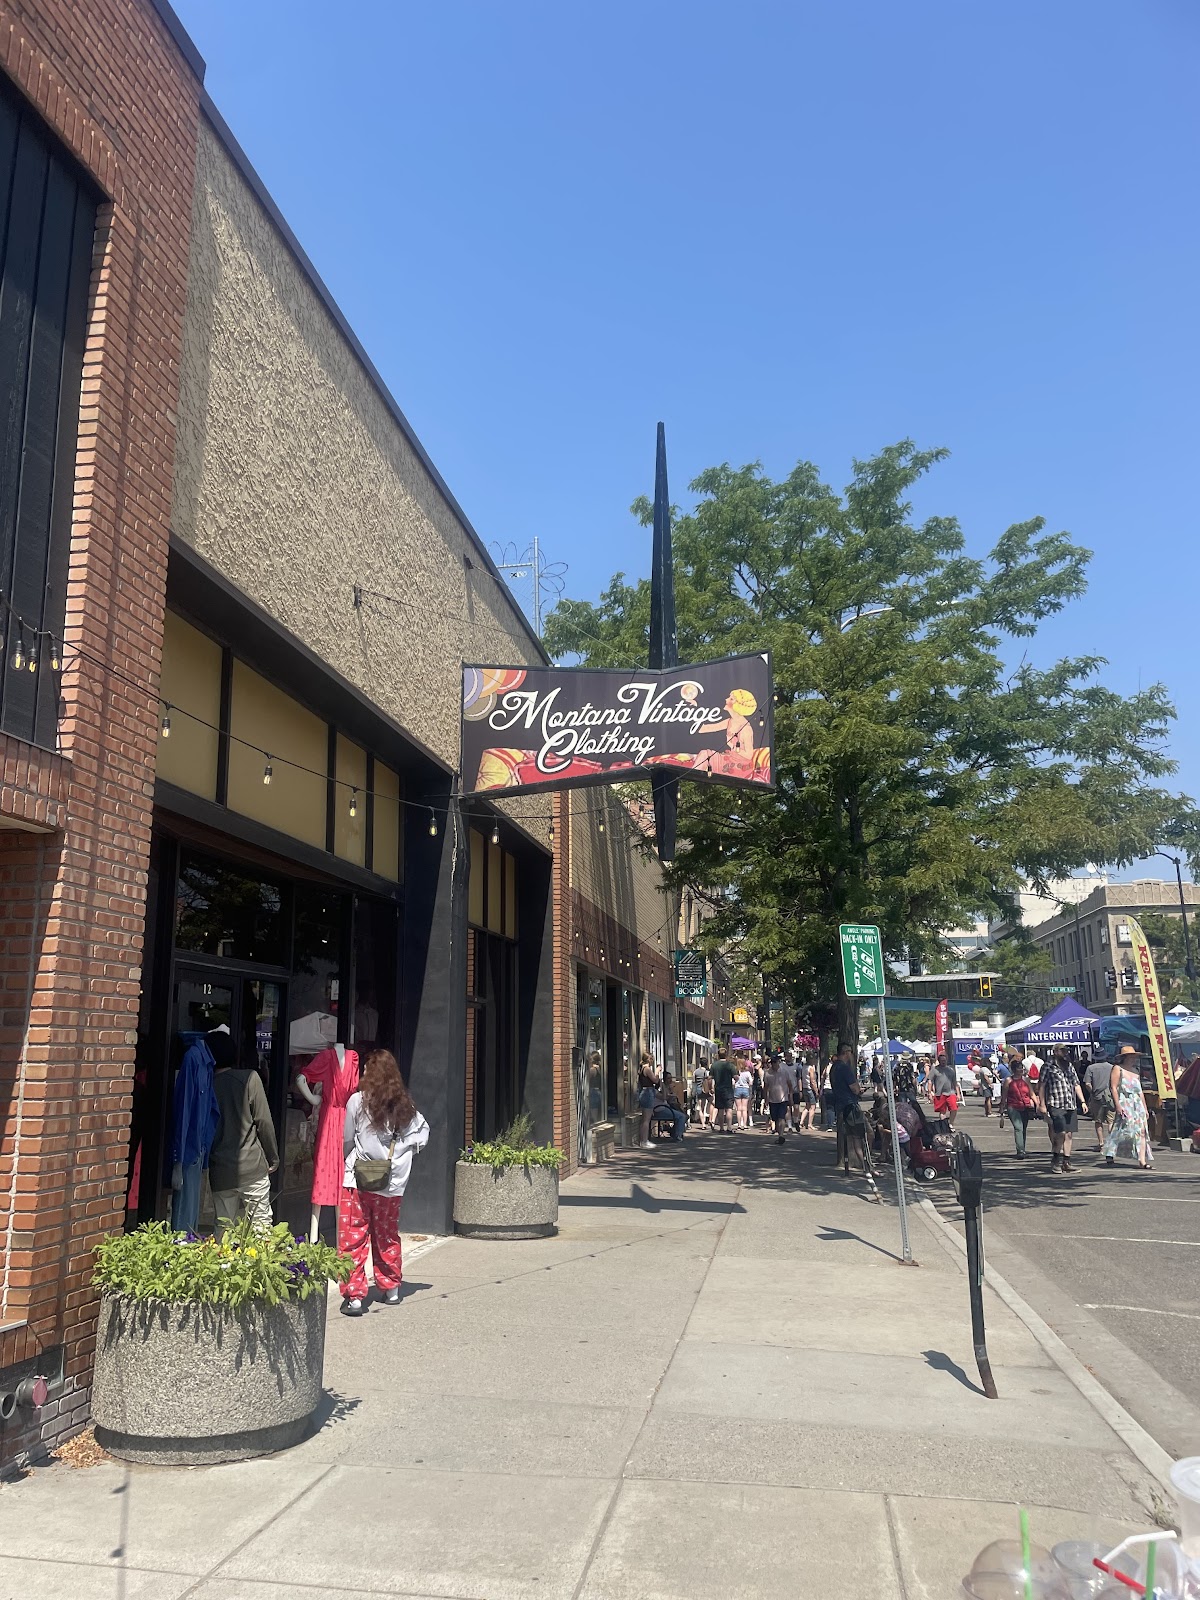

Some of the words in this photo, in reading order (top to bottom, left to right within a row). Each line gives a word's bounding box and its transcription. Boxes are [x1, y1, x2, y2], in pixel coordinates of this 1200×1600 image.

[488, 686, 631, 737] Montana
[617, 680, 722, 734] Vintage
[537, 725, 655, 773] Clothing
[842, 934, 863, 944] BACK-IN
[864, 935, 878, 944] ONLY
[203, 983, 212, 995] 12
[679, 987, 703, 995] BOOKS
[1027, 1031, 1073, 1041] INTERNET
